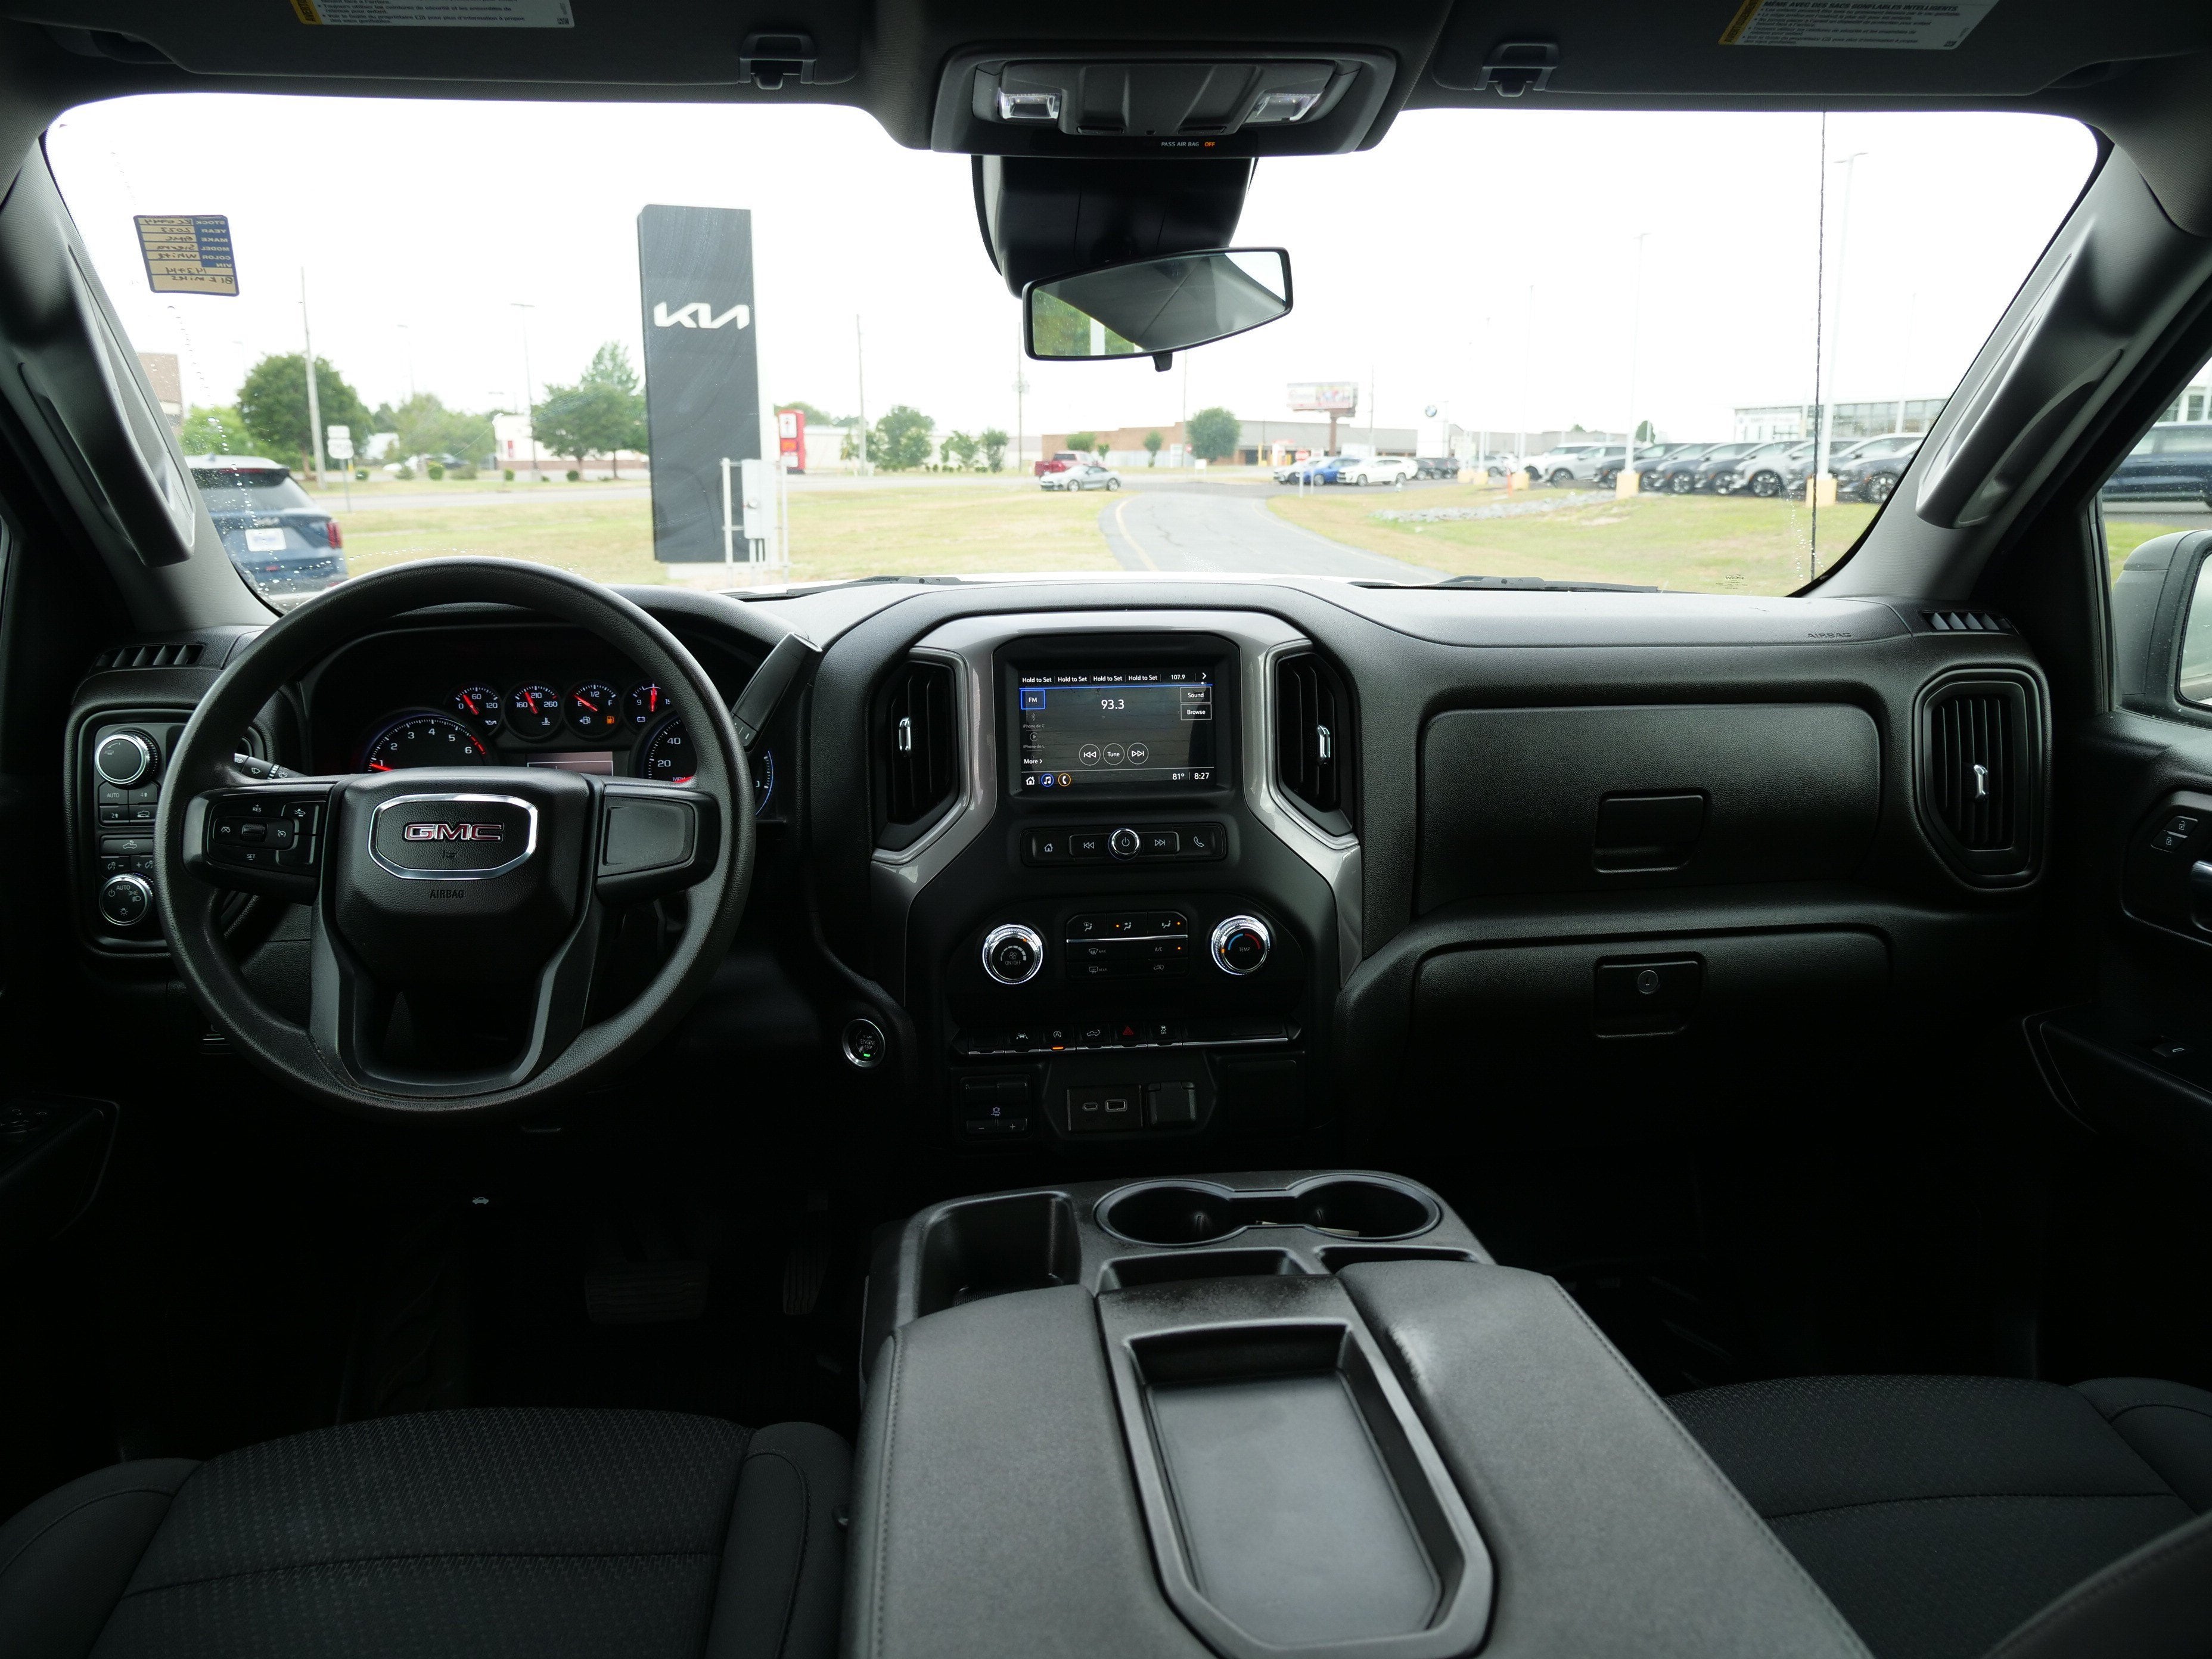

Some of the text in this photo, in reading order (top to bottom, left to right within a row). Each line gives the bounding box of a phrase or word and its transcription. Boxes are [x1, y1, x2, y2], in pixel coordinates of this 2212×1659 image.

[1101, 699, 1124, 709] 93.3
[657, 759, 671, 768] 20
[405, 822, 503, 841] GMC
[430, 889, 464, 899] AIRBAG
